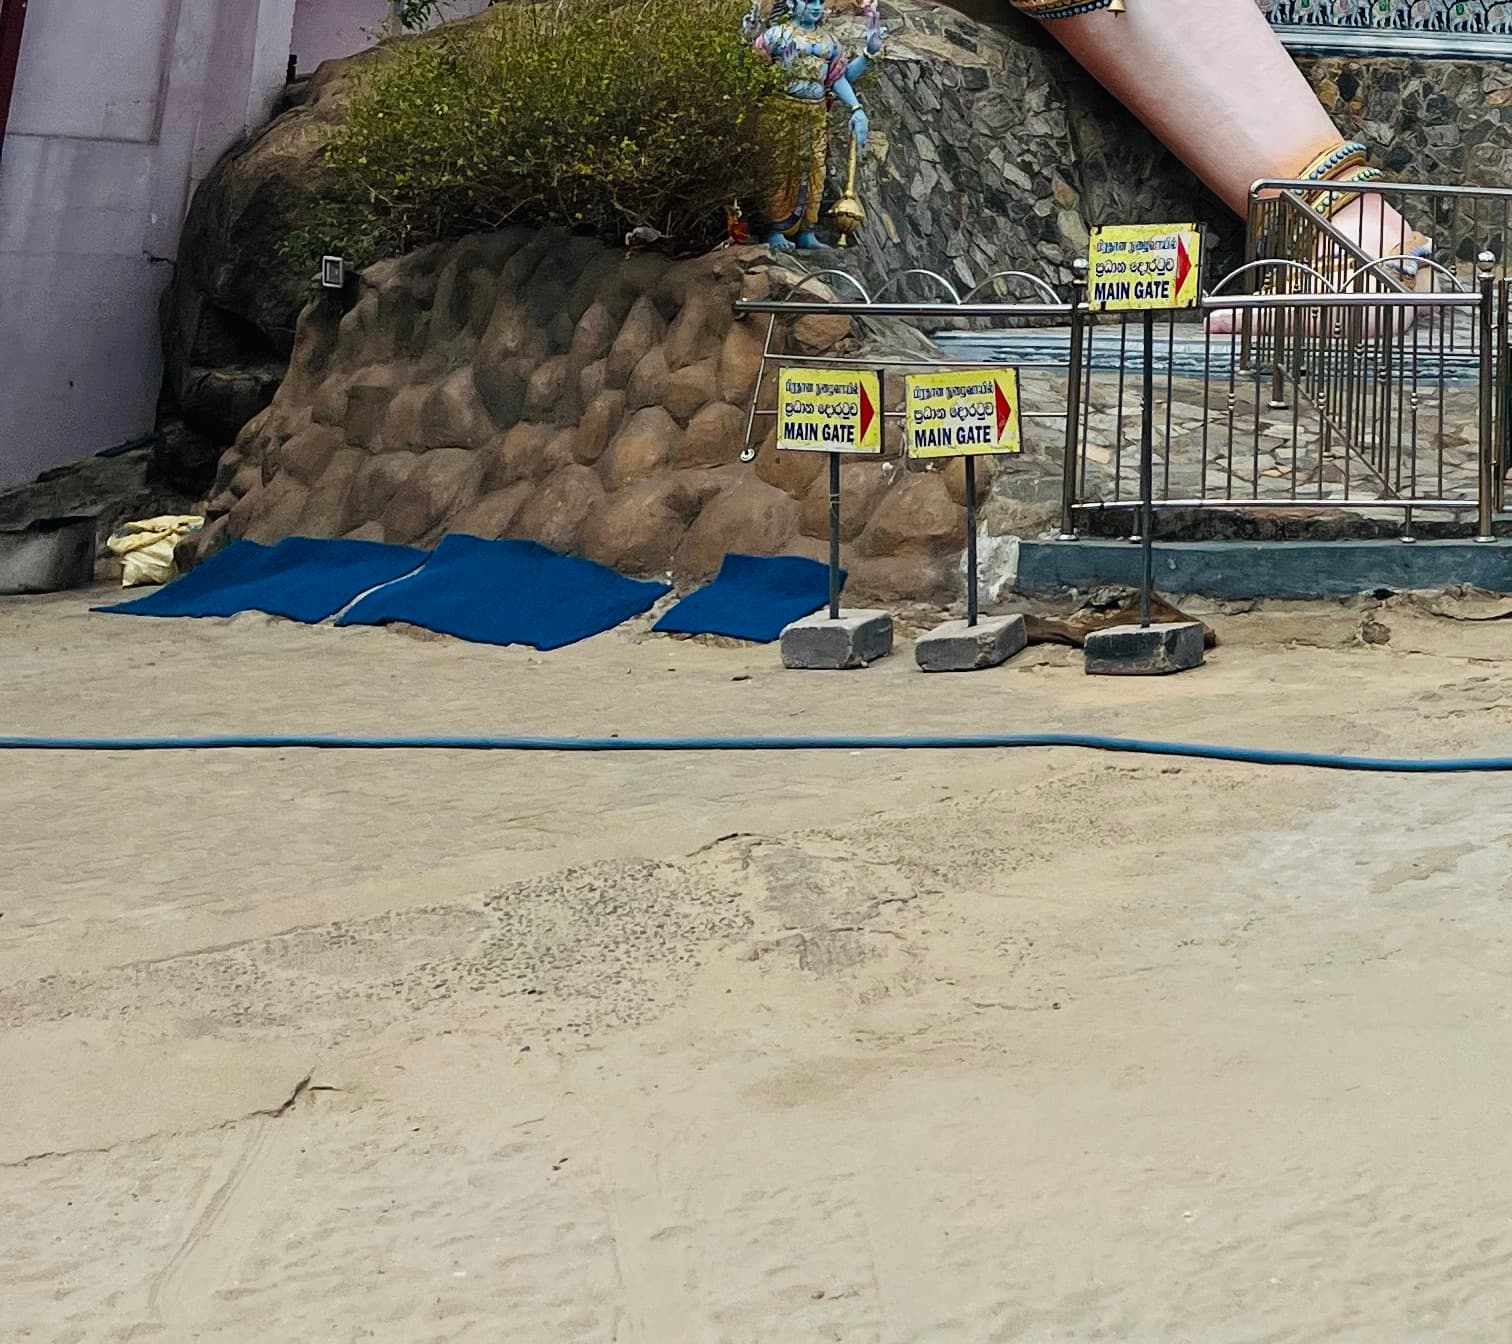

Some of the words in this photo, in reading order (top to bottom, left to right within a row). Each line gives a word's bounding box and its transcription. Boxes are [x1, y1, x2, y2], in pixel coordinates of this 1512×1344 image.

[1095, 282, 1130, 301] MAIN
[1134, 281, 1170, 299] GATE
[784, 422, 818, 441] MAIN
[822, 424, 855, 443] GATE
[914, 428, 951, 448] MAIN
[956, 426, 991, 445] GATE
